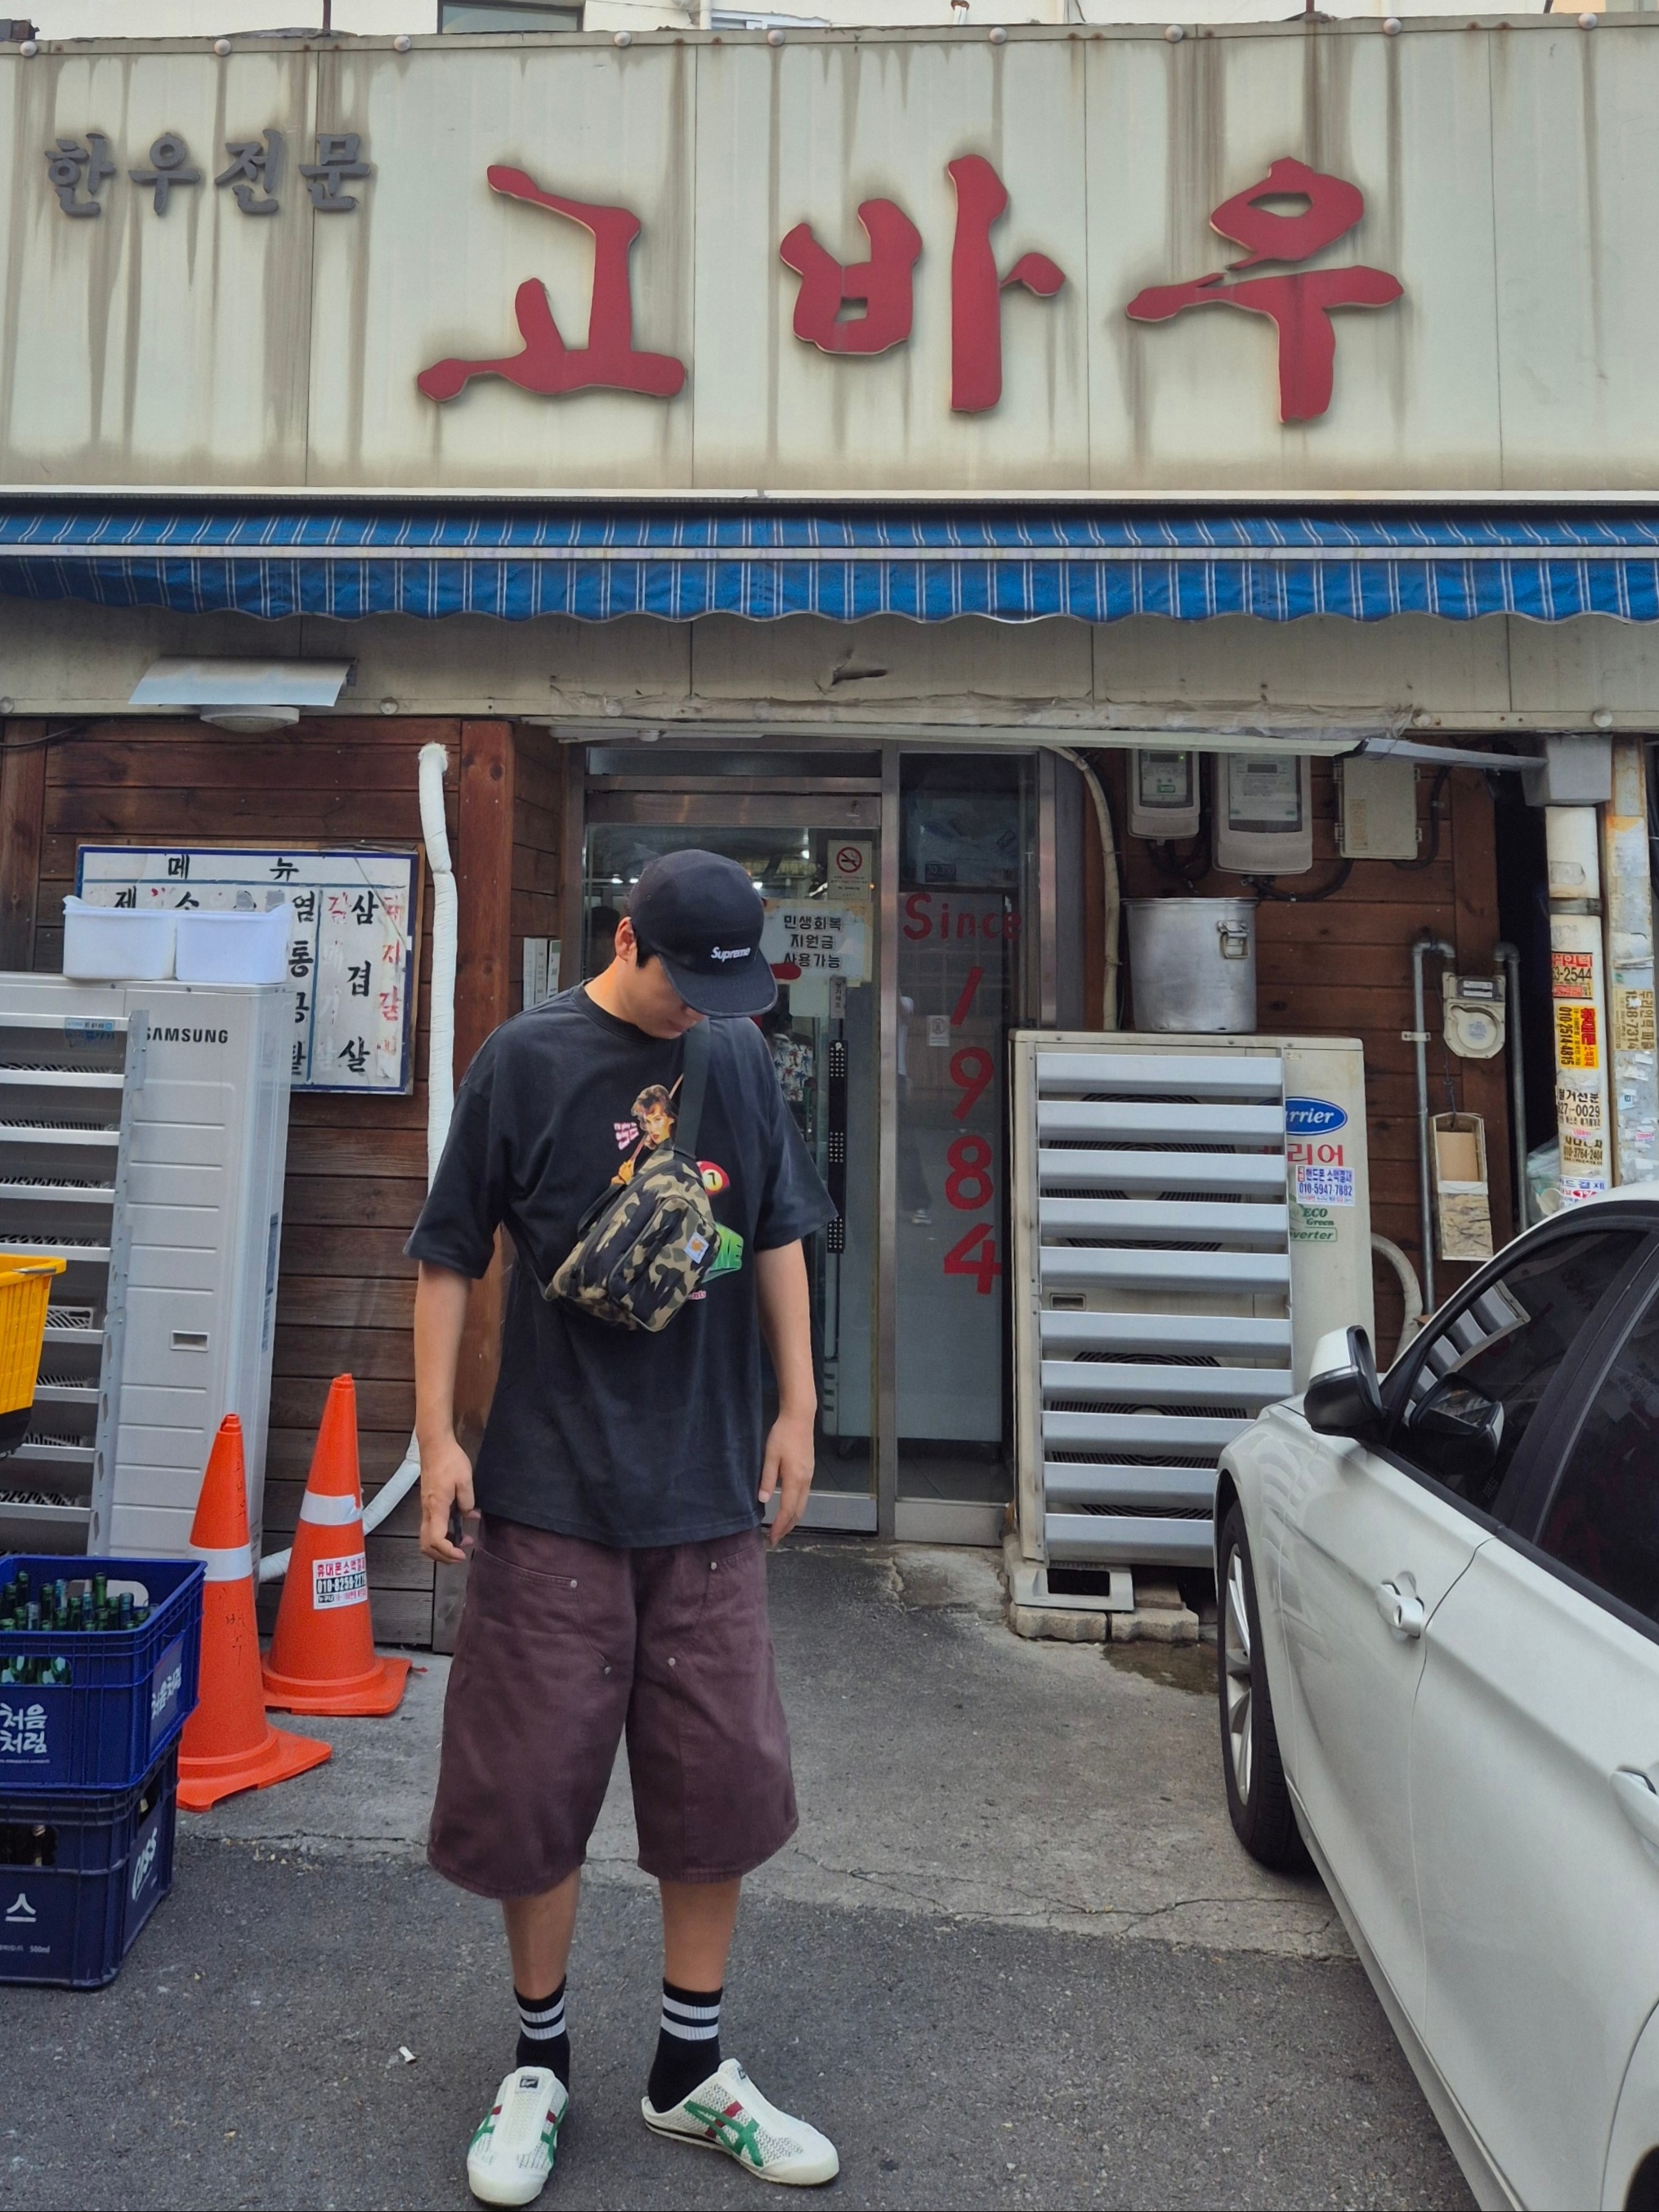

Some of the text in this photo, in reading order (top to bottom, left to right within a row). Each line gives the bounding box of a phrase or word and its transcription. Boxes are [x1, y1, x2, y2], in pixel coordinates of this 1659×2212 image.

[45, 128, 371, 217] 한우전문
[417, 154, 1405, 422] 고바우
[784, 914, 843, 931] 민생회복
[903, 892, 1022, 941] Since
[790, 934, 834, 950] 지원금
[711, 946, 751, 963] Supreme
[785, 952, 841, 969] 사용가능
[338, 890, 379, 1074] 삼겹살
[1268, 1144, 1344, 1166] 리어
[1303, 1208, 1328, 1218] ECO
[1307, 1218, 1335, 1227] Green
[151, 1664, 182, 1720] 처음처럼
[0, 1703, 47, 1731] 처음
[0, 1731, 47, 1754] 처럼
[6, 1892, 37, 1923] 스
